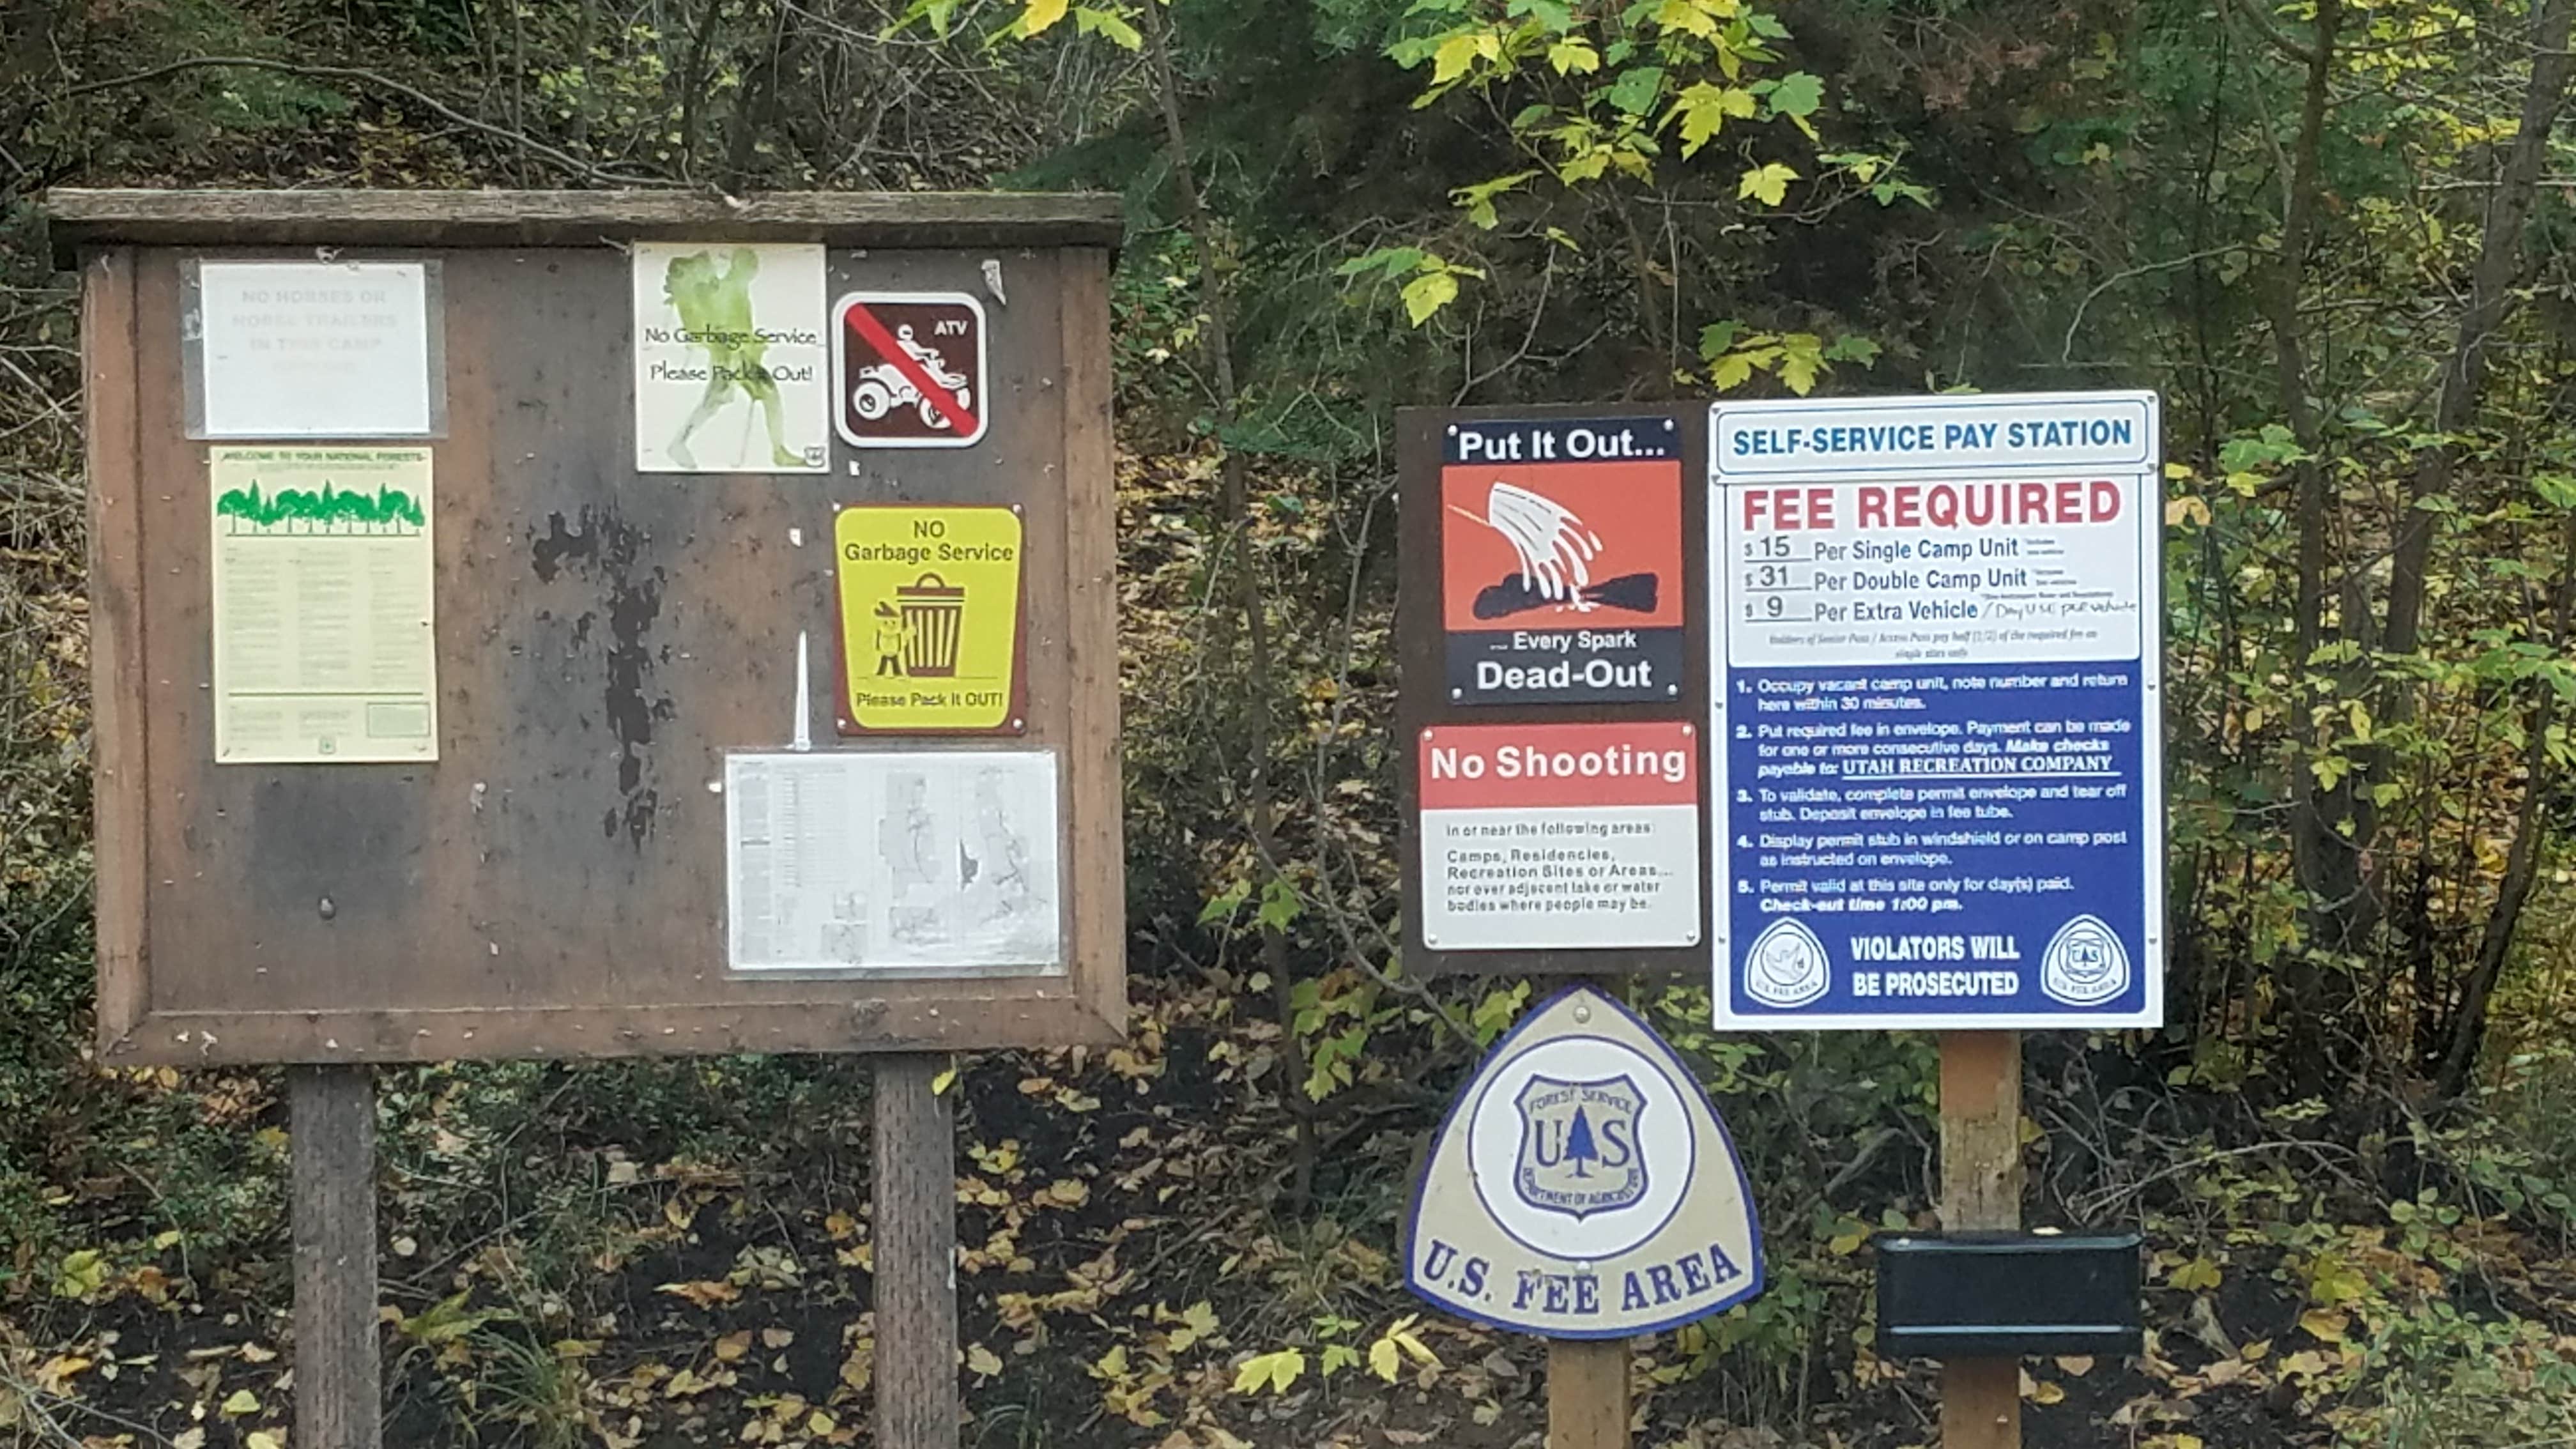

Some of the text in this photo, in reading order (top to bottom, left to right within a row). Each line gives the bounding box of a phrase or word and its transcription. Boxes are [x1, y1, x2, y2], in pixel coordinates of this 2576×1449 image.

[645, 328, 670, 342] No
[754, 328, 816, 344] Service
[934, 321, 968, 336] ATV
[650, 360, 707, 380] Please
[1459, 429, 1664, 459] Put It Out...
[1734, 419, 2132, 456] SELF-SERVICE PAY STATION
[1744, 480, 2122, 531] FEE REQUIRED
[914, 521, 945, 538] NO
[845, 543, 1013, 565] Garbage Service
[1760, 535, 2019, 563] 15 Per Single Camp Unit
[1759, 565, 2027, 592] 31 Per Double Camp Unit
[1767, 595, 1977, 622] 9 Per Extra Vehicle
[1513, 630, 1637, 654] Every Spark
[1477, 658, 1652, 689] Dead-Out
[1758, 679, 1814, 695] Occupy
[1952, 677, 1986, 689] note
[1989, 675, 2046, 688] number
[2050, 673, 2079, 687] and
[2083, 674, 2128, 686] return
[857, 693, 905, 706] Please
[1841, 697, 1860, 710] 30
[1758, 725, 1783, 737] Put
[1787, 723, 1846, 739] required
[1850, 724, 1873, 736] fee
[1876, 723, 1890, 735] in
[1966, 721, 2031, 736] Payment
[2034, 722, 2062, 733] can
[2066, 720, 2085, 733] be
[2089, 719, 2131, 732] made
[1758, 744, 1779, 756] for
[1781, 746, 1809, 756] one
[1813, 746, 1828, 756] or
[1873, 740, 1959, 755] consecutive
[2005, 739, 2049, 753] Make
[1431, 744, 1686, 783] No Shooting
[1758, 755, 2113, 779] payable UTAH RECREATION COMPANY
[1759, 788, 1776, 802] To
[1845, 787, 1914, 804] complete
[1918, 786, 1965, 802] permit
[1968, 785, 2037, 801] envelope
[2041, 785, 2069, 798] and
[2073, 785, 2103, 798] tear
[2106, 783, 2127, 797] off
[1800, 807, 1857, 822] Deposit
[1860, 806, 1927, 822] envelope
[1948, 805, 1971, 818] fee
[1481, 825, 1512, 836] near
[1515, 824, 1538, 835] the
[1541, 821, 1608, 838] following
[1759, 831, 2128, 850] Display permit stub in windshield or on camp post
[1781, 853, 1853, 866] instructed
[1857, 854, 1877, 866] on
[1447, 866, 1538, 880] Recreation
[1542, 864, 1583, 878] Sites
[1588, 866, 1604, 877] or
[1447, 881, 1659, 897] nor over adjacent lake or water
[1759, 879, 1808, 893] Permit
[1811, 878, 1846, 893] valid
[1850, 880, 1865, 892] at
[1868, 878, 1894, 892] this
[1898, 878, 1924, 891] site
[1929, 878, 1960, 894] only
[1963, 878, 1984, 891] for
[1988, 877, 2033, 893] day(s)
[1447, 897, 1625, 913] bodies where people may
[1759, 898, 1844, 912] Check-out
[1848, 897, 1885, 911] time
[1892, 896, 1928, 911] 1:00
[1851, 936, 2020, 961] VIOLATORS WILL
[1853, 972, 2019, 997] BE PROSECUTED
[1529, 1088, 1632, 1114] FOREST SERVICE
[1423, 1239, 1743, 1314] U.S. FEE AREA
